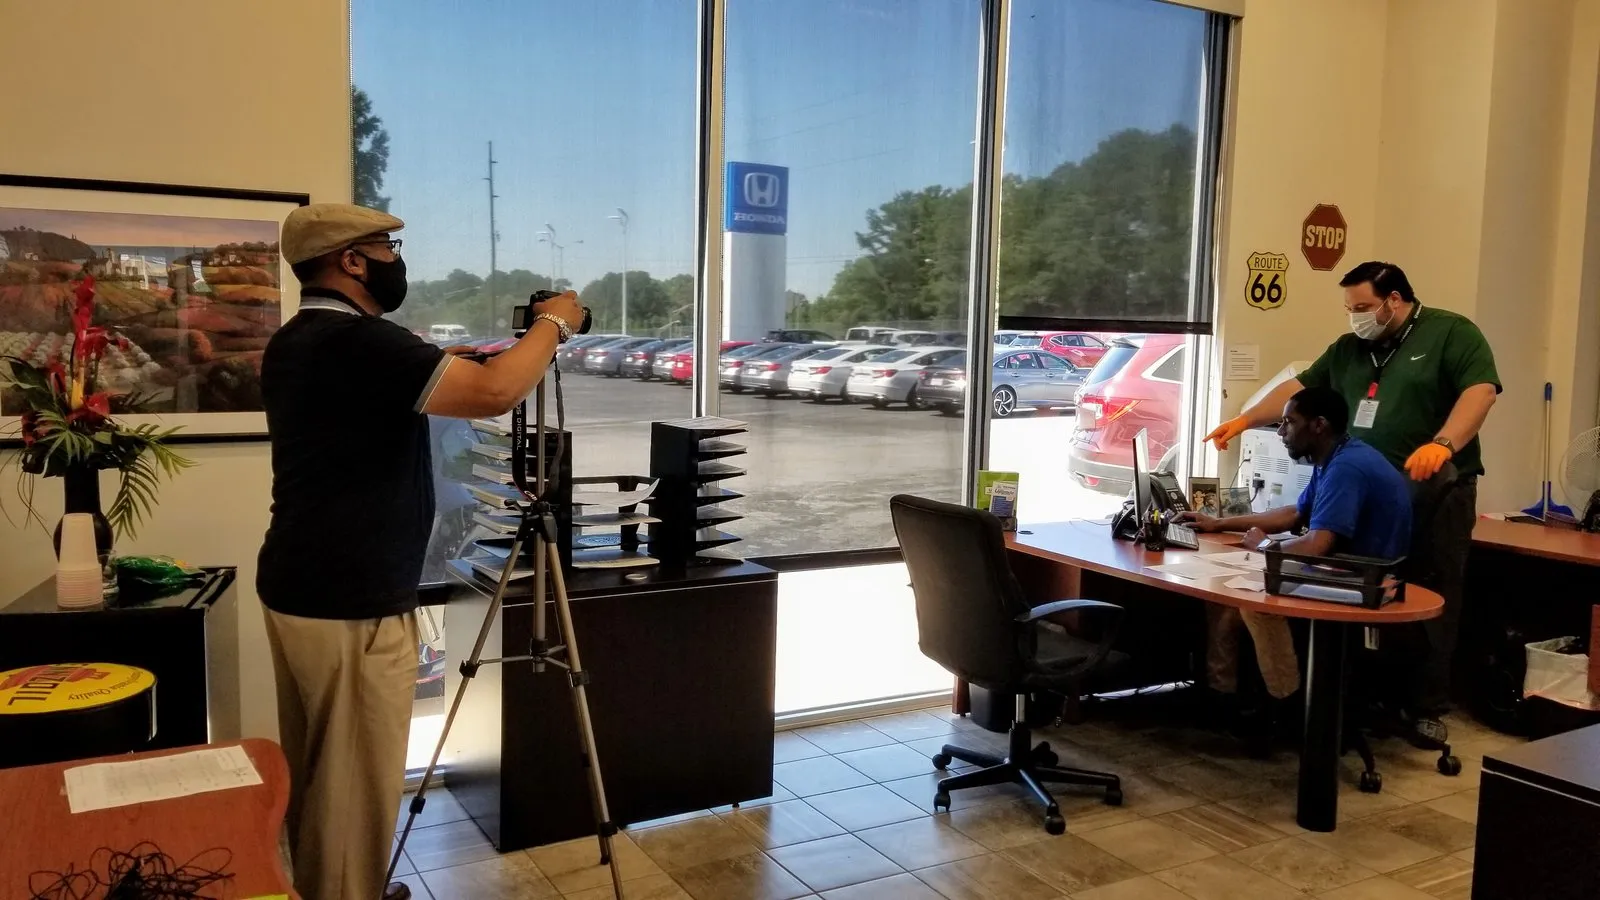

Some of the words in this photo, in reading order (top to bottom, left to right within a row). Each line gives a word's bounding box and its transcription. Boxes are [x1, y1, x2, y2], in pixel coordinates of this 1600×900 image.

[734, 212, 786, 225] HONDA
[1305, 225, 1344, 250] STOP
[1254, 257, 1283, 269] ROUTE
[1251, 273, 1282, 304] 66
[67, 688, 111, 701] Quality
